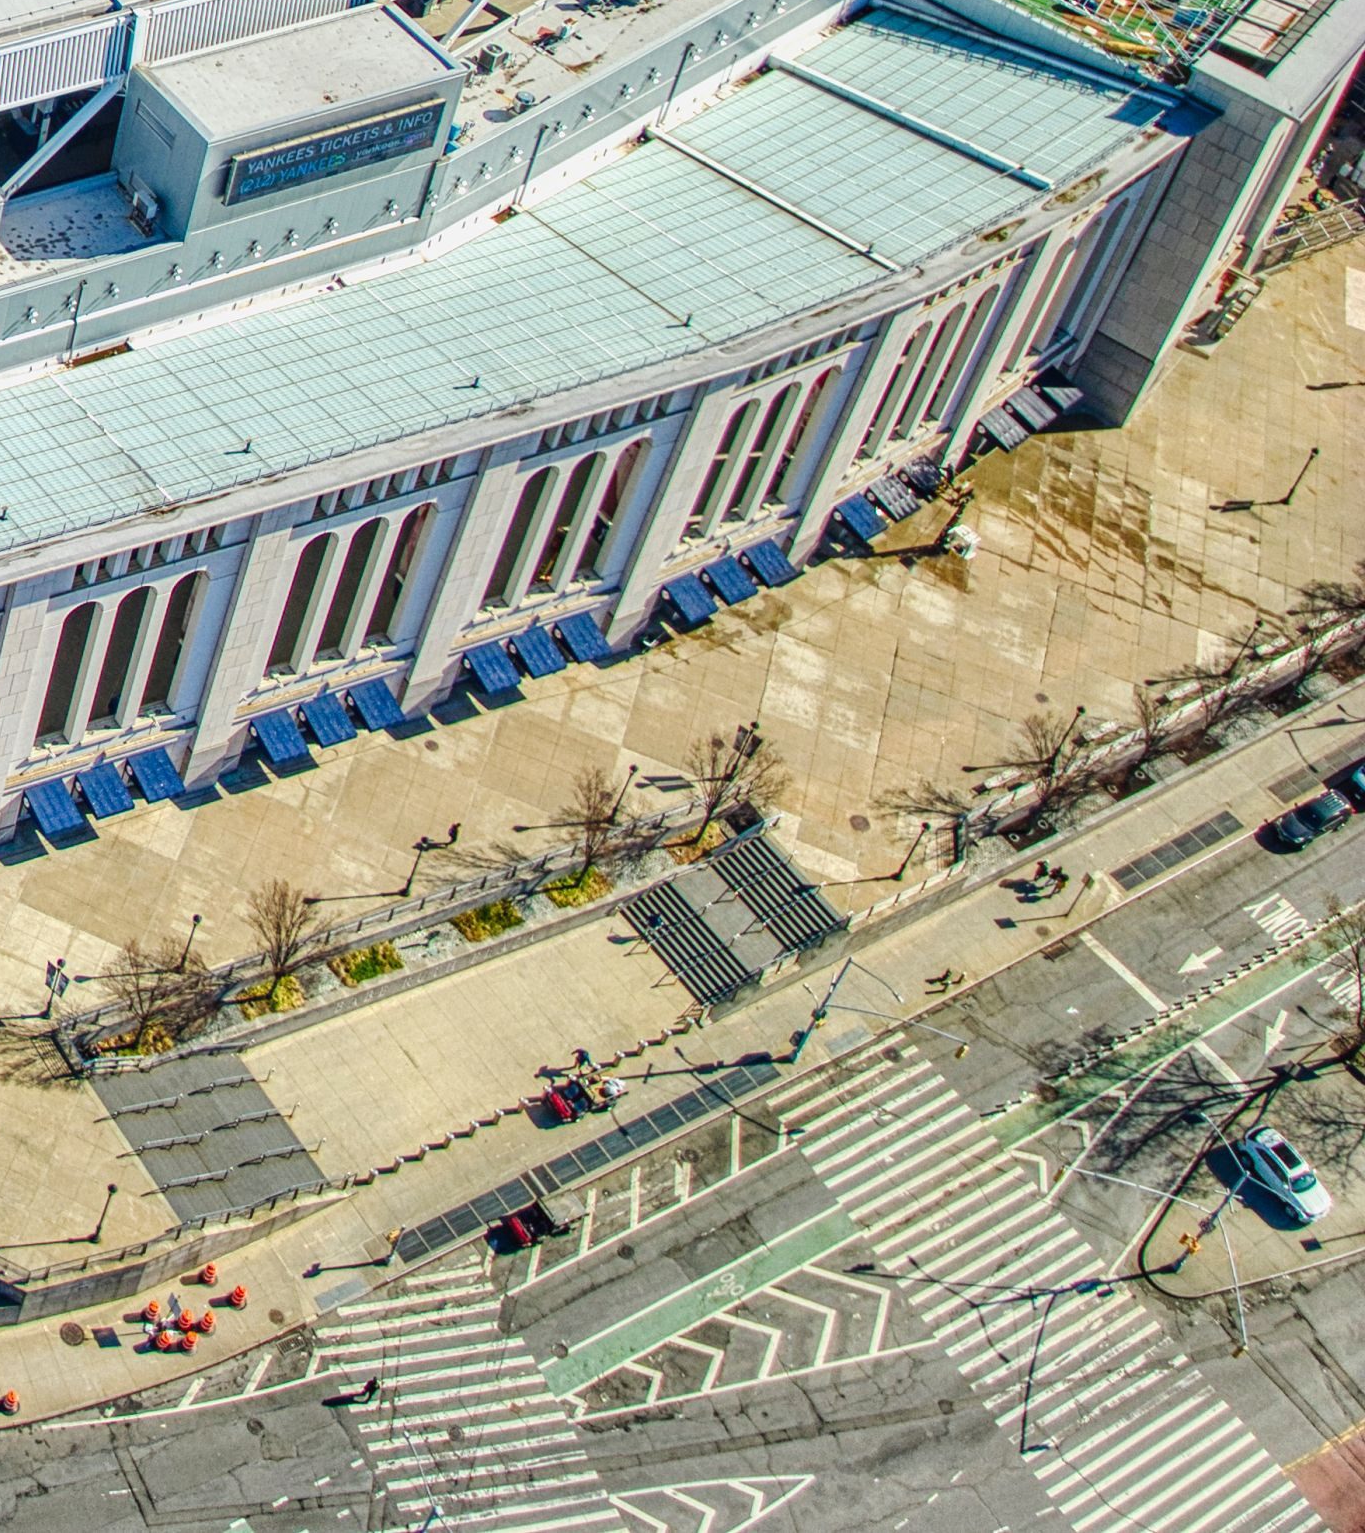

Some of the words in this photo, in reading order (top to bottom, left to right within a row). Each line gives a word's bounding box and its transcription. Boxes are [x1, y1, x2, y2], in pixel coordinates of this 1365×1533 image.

[247, 145, 315, 175] YANKEES
[320, 127, 379, 154] TICKETS
[383, 124, 393, 136] &
[397, 111, 433, 131] INFO
[239, 174, 275, 194] (212)
[279, 152, 347, 182] YANKEES
[1242, 893, 1311, 944] ONLY
